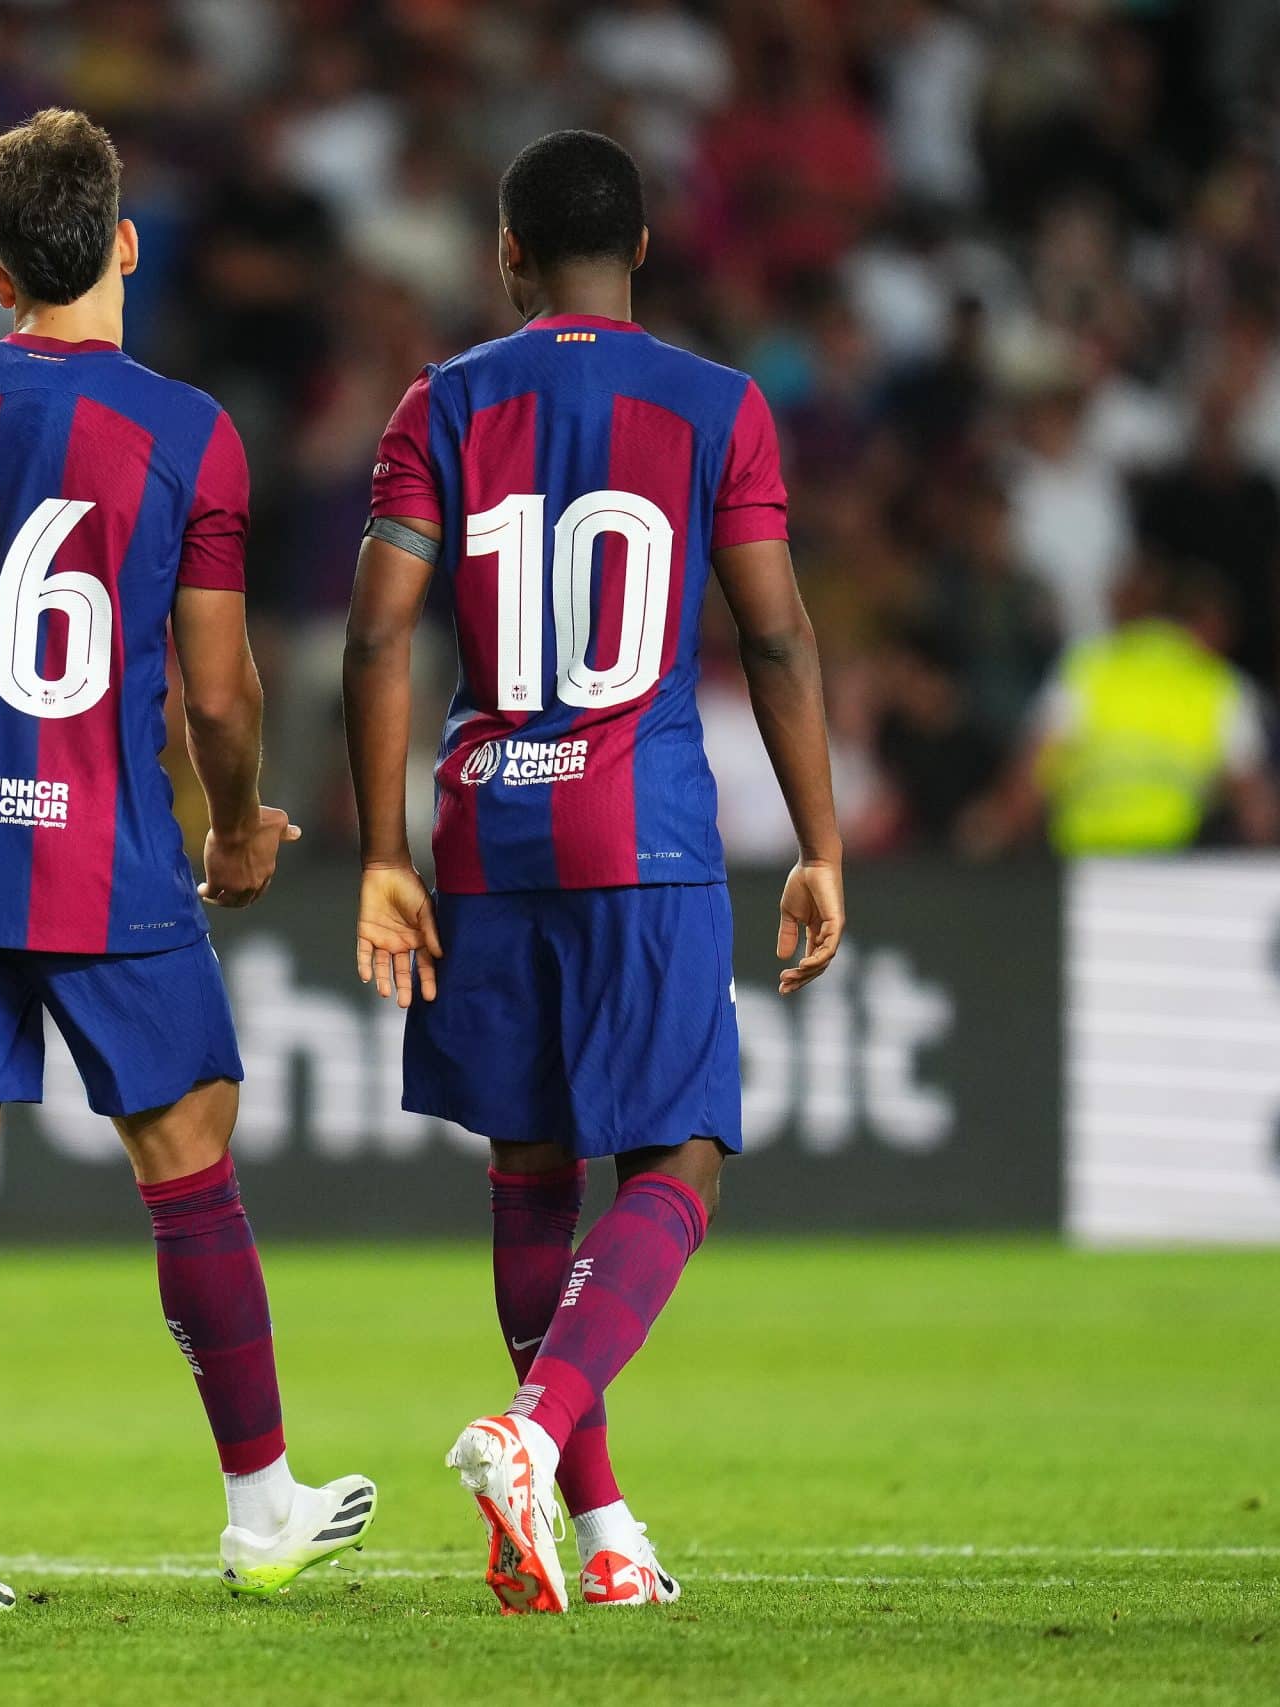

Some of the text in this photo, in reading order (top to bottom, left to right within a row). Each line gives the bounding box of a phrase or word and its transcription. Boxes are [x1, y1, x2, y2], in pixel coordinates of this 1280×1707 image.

[466, 490, 673, 711] 10
[505, 740, 588, 760] UNHCR
[502, 756, 586, 778] ACNUR
[503, 777, 517, 786] The
[518, 777, 530, 785] UN
[558, 772, 584, 782] Agency
[8, 817, 38, 828] Refugee
[39, 820, 67, 830] Agency
[561, 1257, 595, 1308] BARÇA
